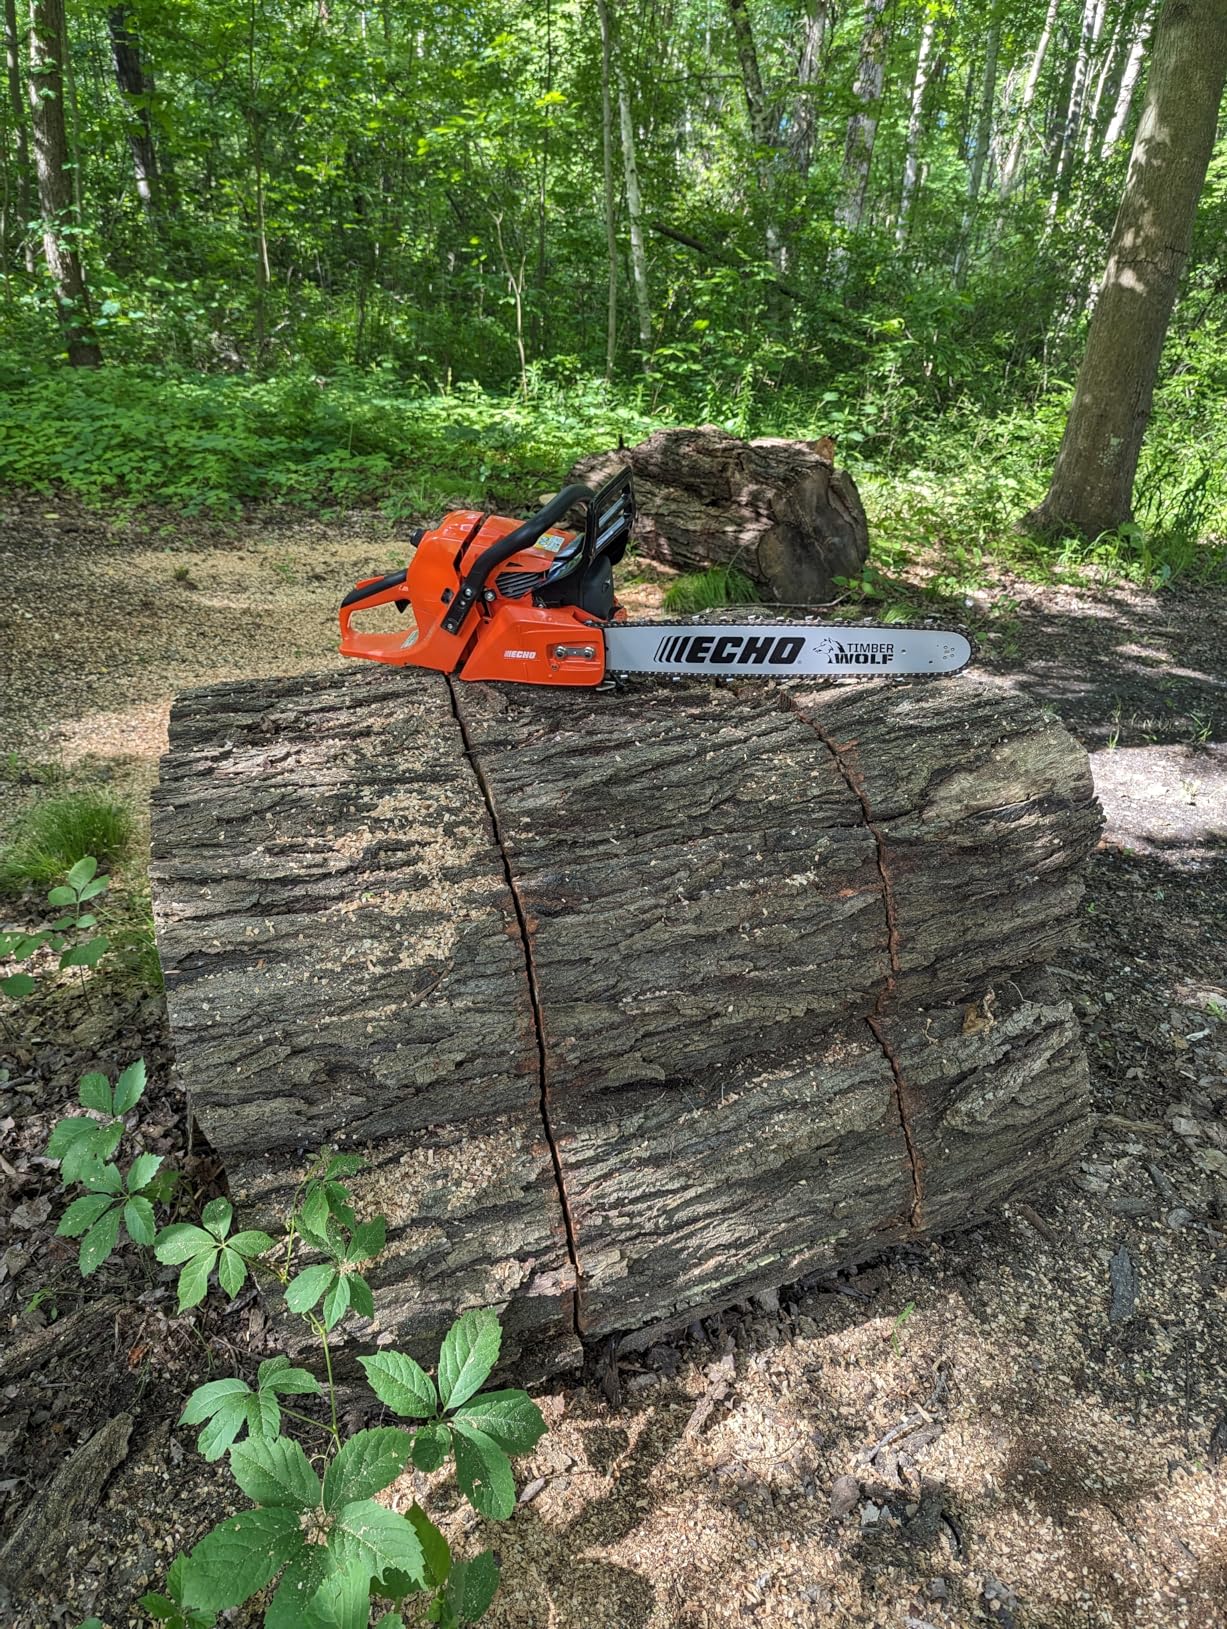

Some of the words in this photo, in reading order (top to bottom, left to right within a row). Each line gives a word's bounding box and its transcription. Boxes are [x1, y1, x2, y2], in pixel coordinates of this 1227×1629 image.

[685, 636, 806, 664] ECHO
[847, 643, 894, 654] TIMBER
[511, 650, 537, 659] ECHO
[835, 653, 894, 664] WOLF
